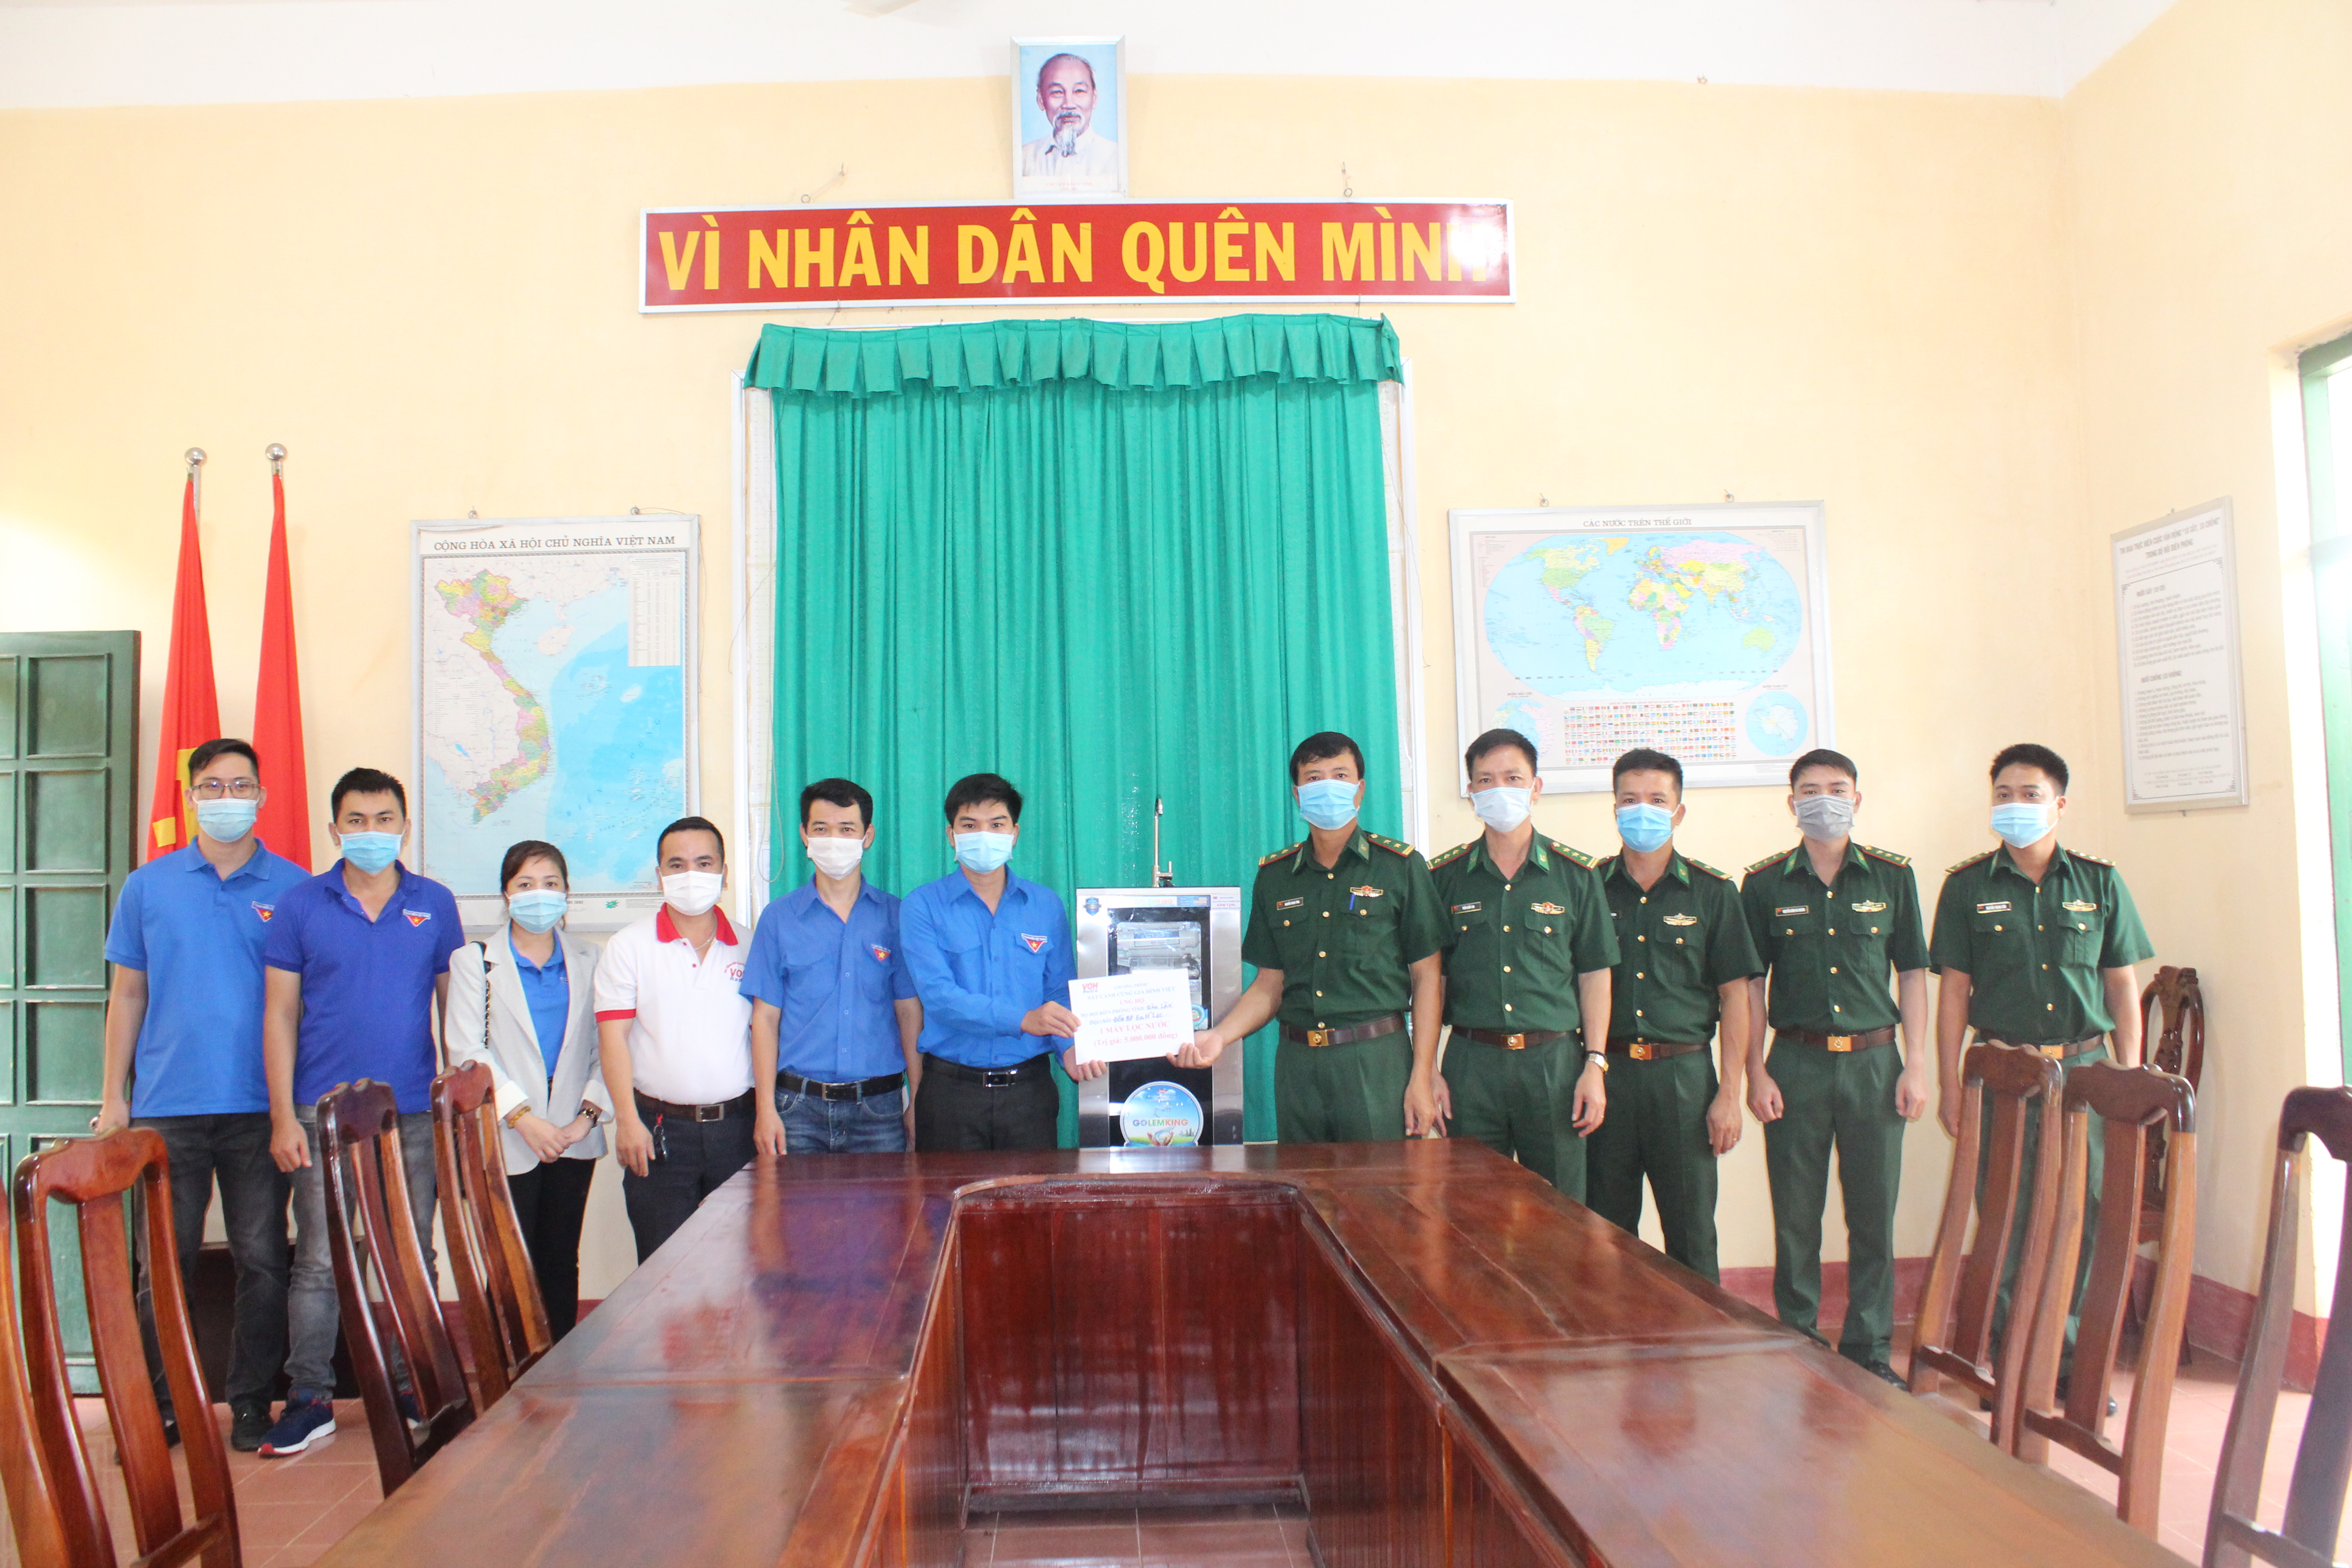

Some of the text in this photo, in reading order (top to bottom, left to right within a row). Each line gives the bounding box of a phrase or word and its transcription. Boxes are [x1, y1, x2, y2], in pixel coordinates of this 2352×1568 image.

[658, 206, 1487, 294] VÌ NHÂN DÂN QUÊN MÌNH
[1583, 516, 1692, 527] CÁC NƯỚC TRÊN THẾ GIỚI
[434, 534, 676, 552] CỘNG HÒA XÃ HỘI CHỦ NGHĨA VIỆT NAM
[730, 968, 744, 978] VO
[1105, 1024, 1124, 1033] MÁY
[1127, 1023, 1143, 1032] LỌC
[1146, 1020, 1170, 1030] NƯỚC
[1124, 1034, 1156, 1043] 5.000.000
[1132, 1118, 1189, 1127] GOLEMKING
